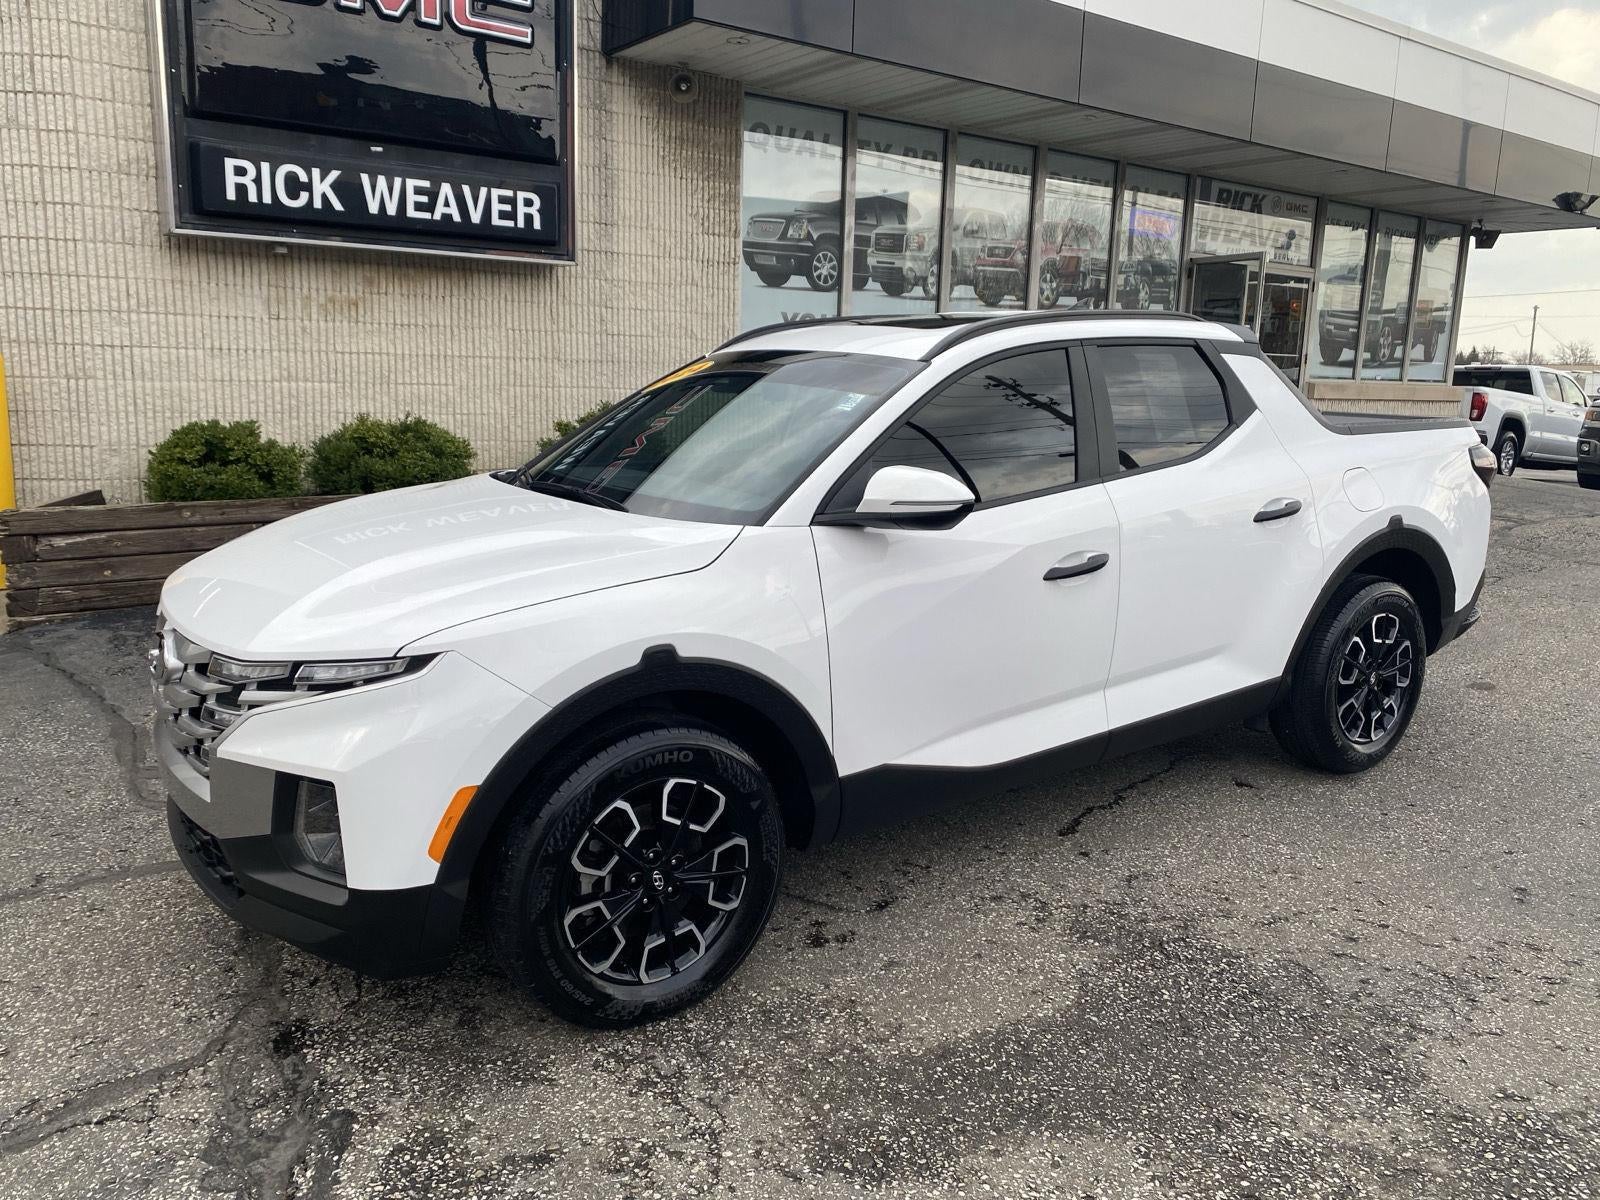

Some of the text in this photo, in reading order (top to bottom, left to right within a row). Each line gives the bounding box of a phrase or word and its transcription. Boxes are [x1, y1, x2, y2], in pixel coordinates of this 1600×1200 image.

[748, 121, 893, 168] QUALTY
[224, 156, 542, 230] RICK WEAVER
[1214, 186, 1269, 215] RICK
[1284, 200, 1309, 214] GMC
[613, 750, 695, 782] KUMHO
